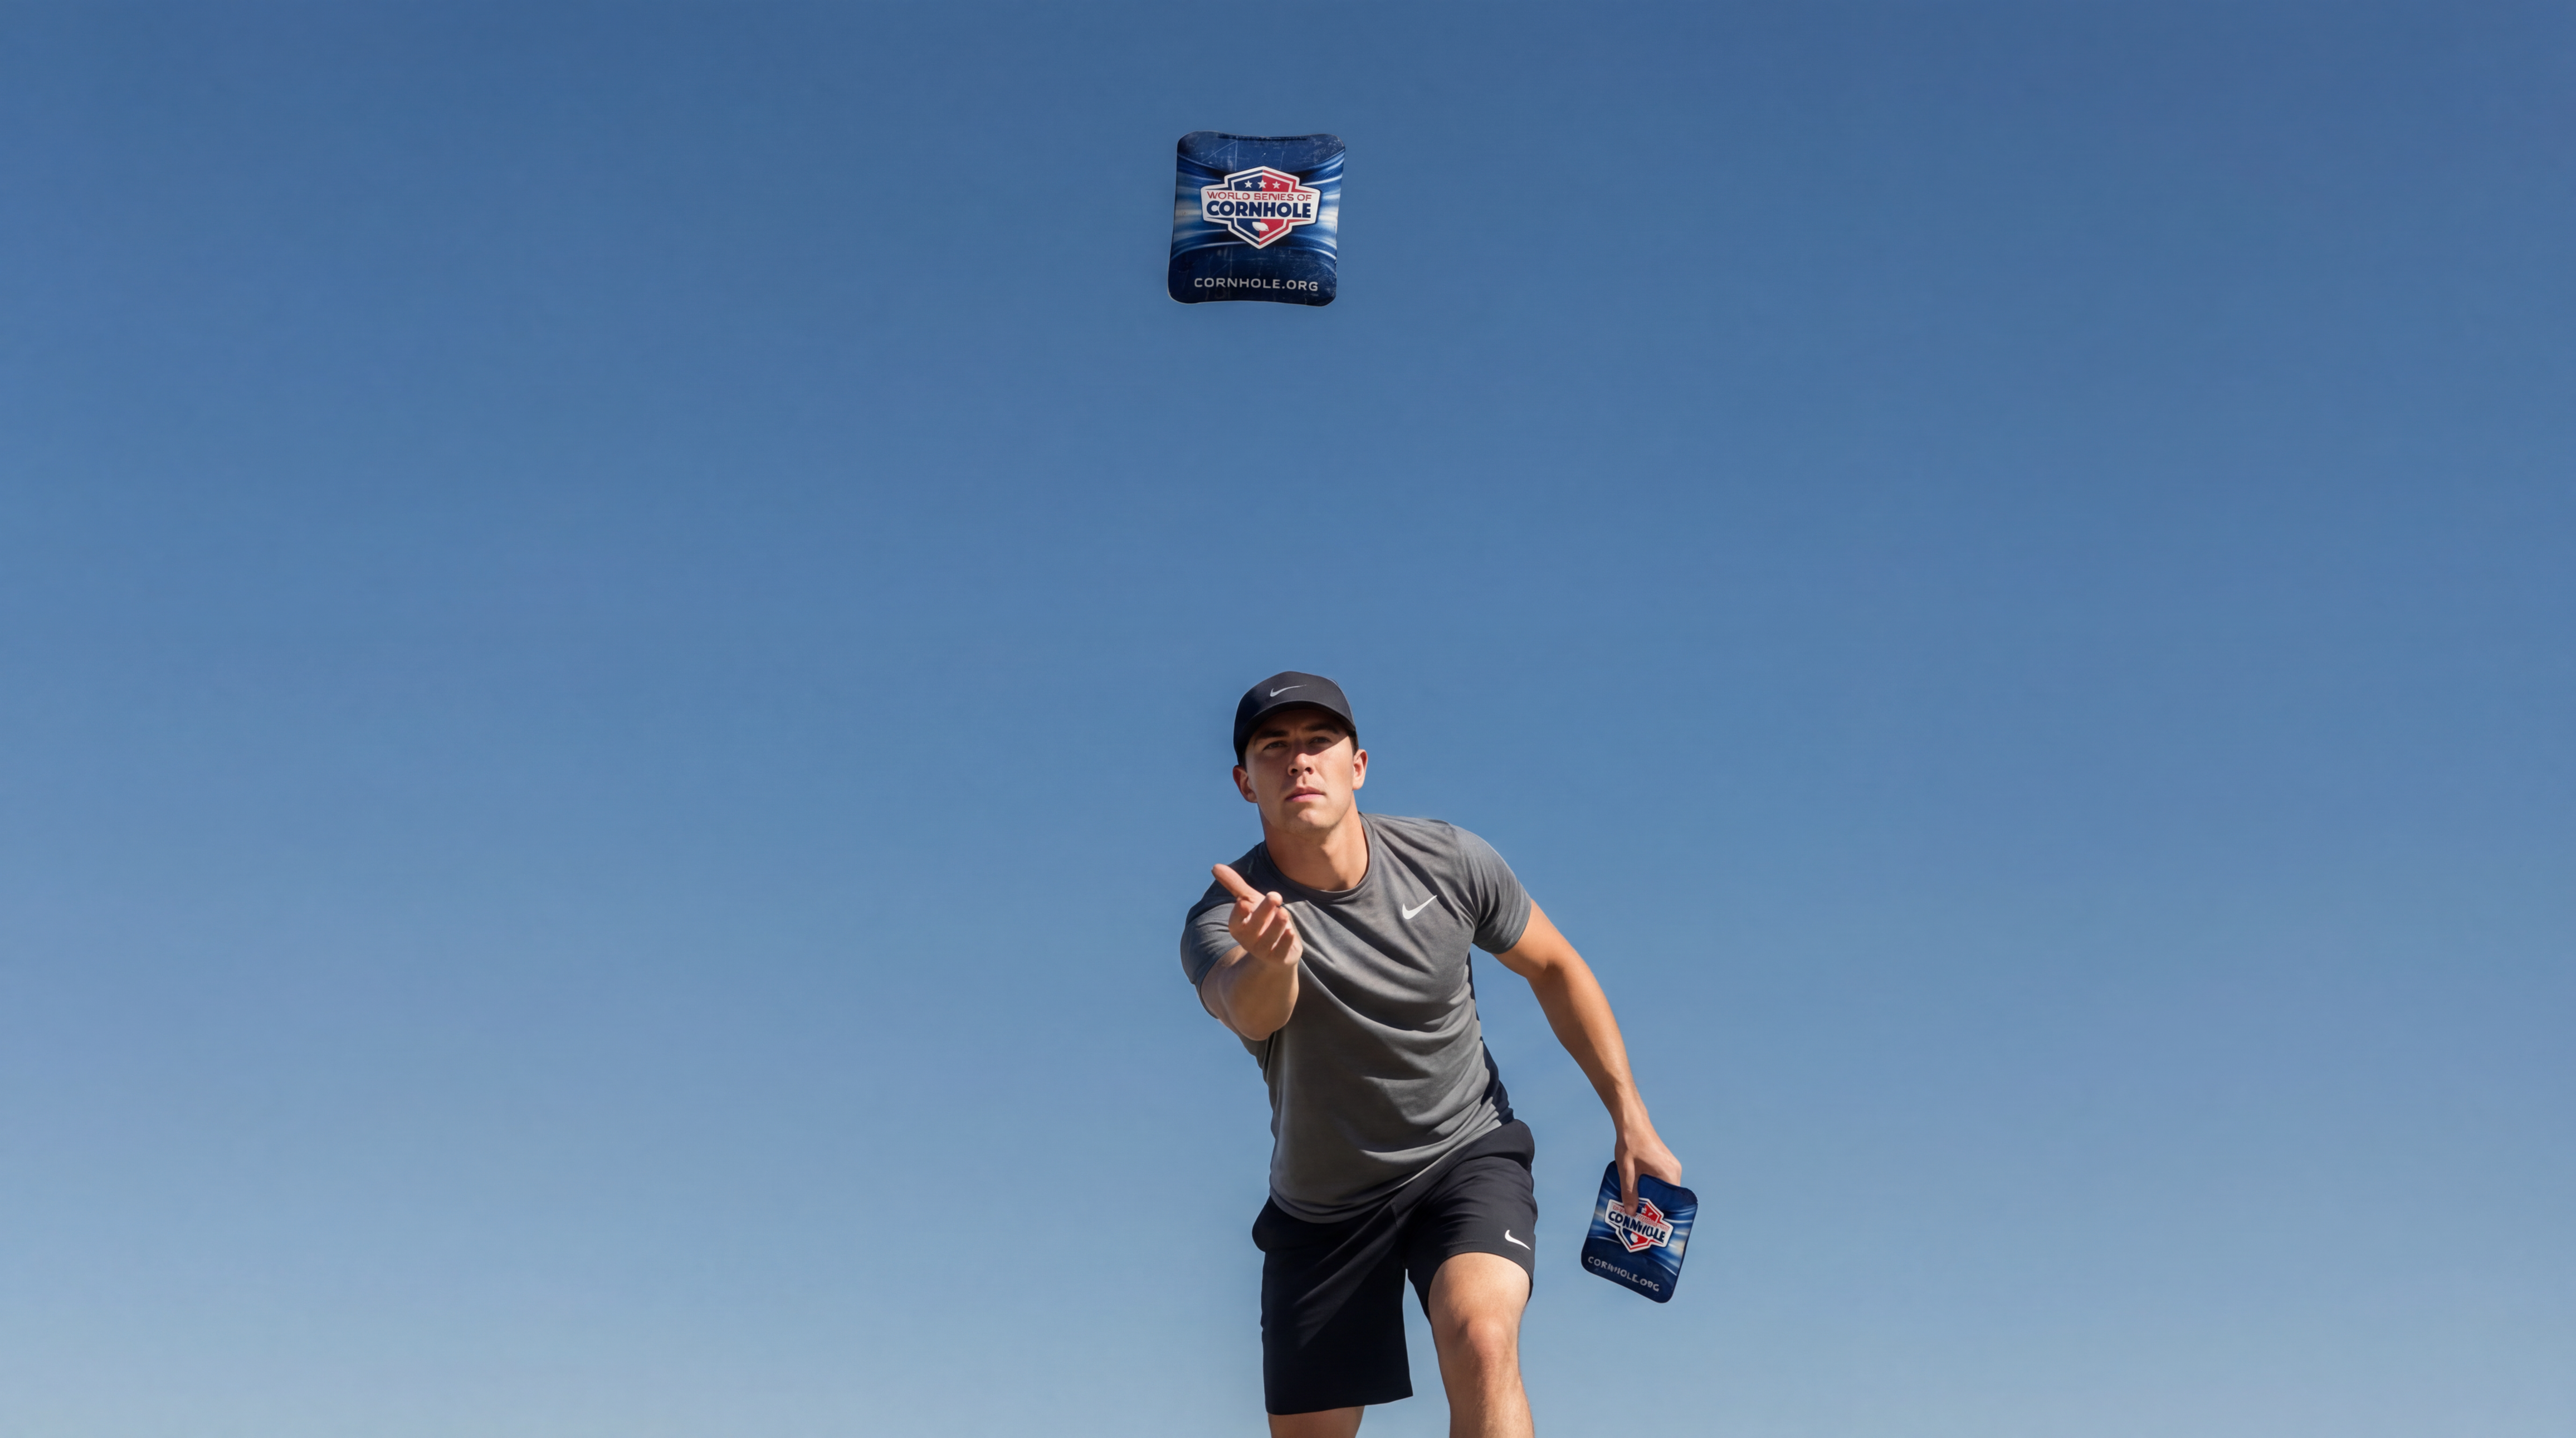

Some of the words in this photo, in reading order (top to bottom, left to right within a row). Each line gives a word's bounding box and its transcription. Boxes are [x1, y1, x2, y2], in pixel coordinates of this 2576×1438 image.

[1207, 191, 1250, 200] WORLD
[1207, 200, 1311, 218] CORNHOLE
[1194, 278, 1318, 291] CORNHOLE.ORG
